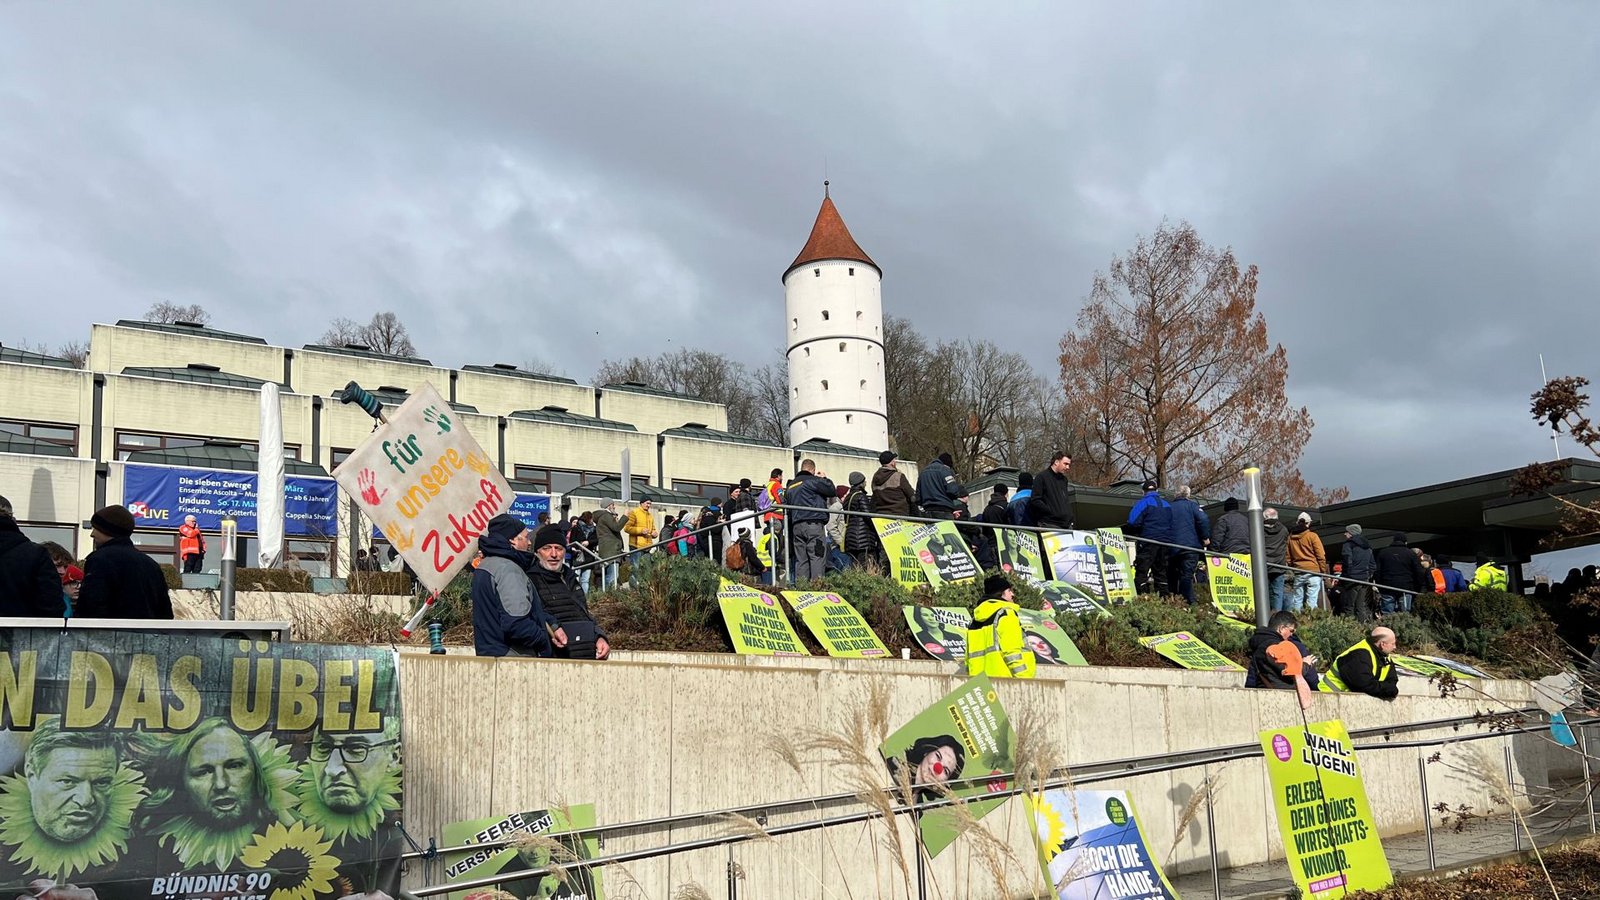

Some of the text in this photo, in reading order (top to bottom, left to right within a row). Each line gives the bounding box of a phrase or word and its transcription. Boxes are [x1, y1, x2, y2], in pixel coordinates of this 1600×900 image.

[382, 434, 423, 474] für
[179, 477, 304, 493] Die sieben Zwerge März
[179, 487, 212, 495] Ensemble
[213, 489, 237, 497] Ascolta
[396, 448, 465, 519] unsere
[178, 497, 211, 505] Unduzo
[143, 509, 169, 519] LIVE
[178, 506, 202, 514] Friede,
[202, 508, 227, 516] Freude,
[228, 509, 257, 517] Götterfu
[285, 512, 312, 520] Cappella
[507, 509, 532, 517] Esslingen
[421, 479, 503, 573] Zukunft
[900, 570, 916, 583] WAS
[1215, 576, 1233, 585] ERLEBE
[750, 603, 780, 620] DAMIT
[823, 605, 852, 616] DAMIT
[742, 612, 786, 632] NACH DER
[821, 616, 861, 628] NACH DER
[739, 622, 793, 643] MIETE NOCH
[824, 627, 870, 640] MIETE NOCH
[742, 635, 801, 653] WAS BLEIBT.
[831, 640, 853, 652] WAS
[64, 650, 203, 730] DAS
[230, 639, 382, 731] ÜBEL
[973, 686, 998, 731] Keine Waffen
[961, 704, 988, 754] Kriegsgebiete.
[965, 692, 977, 706] und
[971, 704, 999, 754] Rüstungsgüter
[1303, 732, 1351, 757] WAHL-
[1303, 749, 1356, 777] LÜGEN!
[1290, 797, 1357, 831] DEIN GRÜNES
[1293, 819, 1369, 855] WIRTSCHAFTS-
[1116, 844, 1143, 869] DIE
[151, 872, 272, 896] BÜNDNIS 90
[1104, 868, 1162, 899] HÄNDE,
